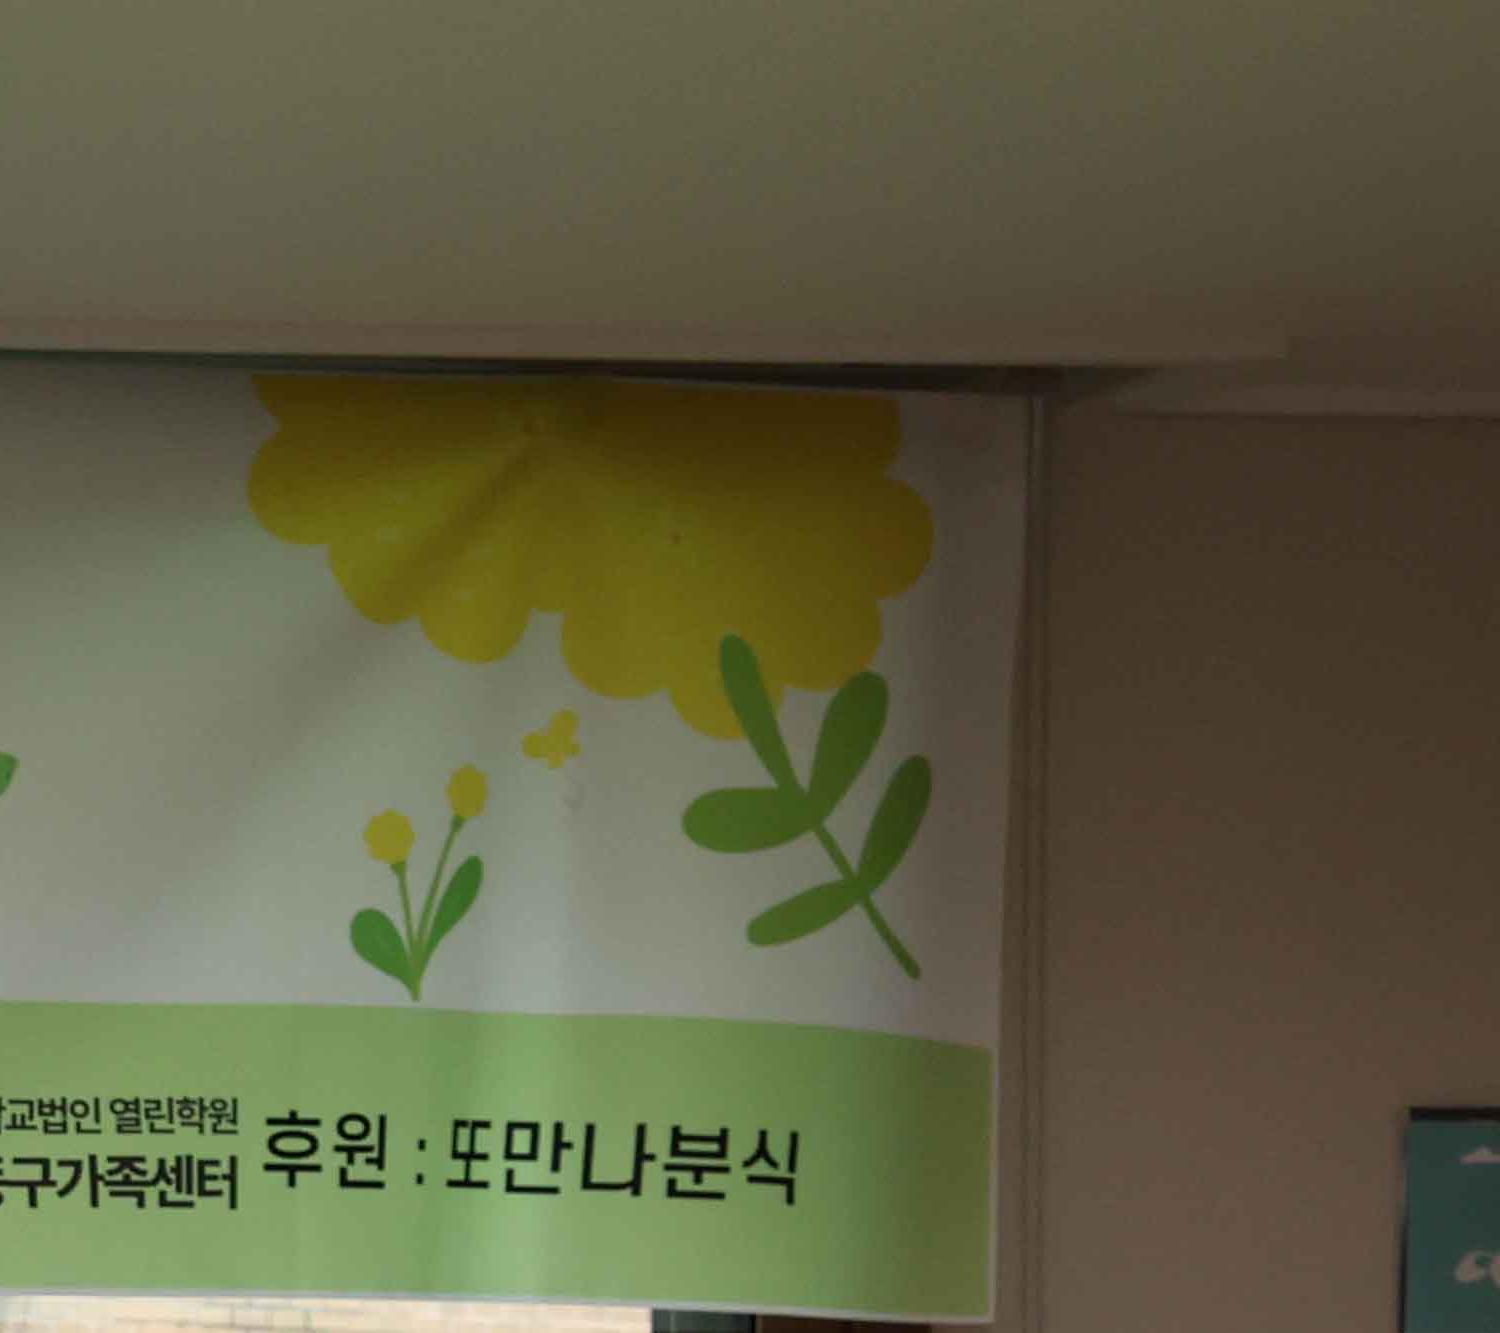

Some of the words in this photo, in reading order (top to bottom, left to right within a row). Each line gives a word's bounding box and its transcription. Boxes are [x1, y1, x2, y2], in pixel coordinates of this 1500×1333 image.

[108, 1096, 240, 1136] 열린학원
[262, 1109, 389, 1191] 후원
[445, 1118, 801, 1206] 또만나분식
